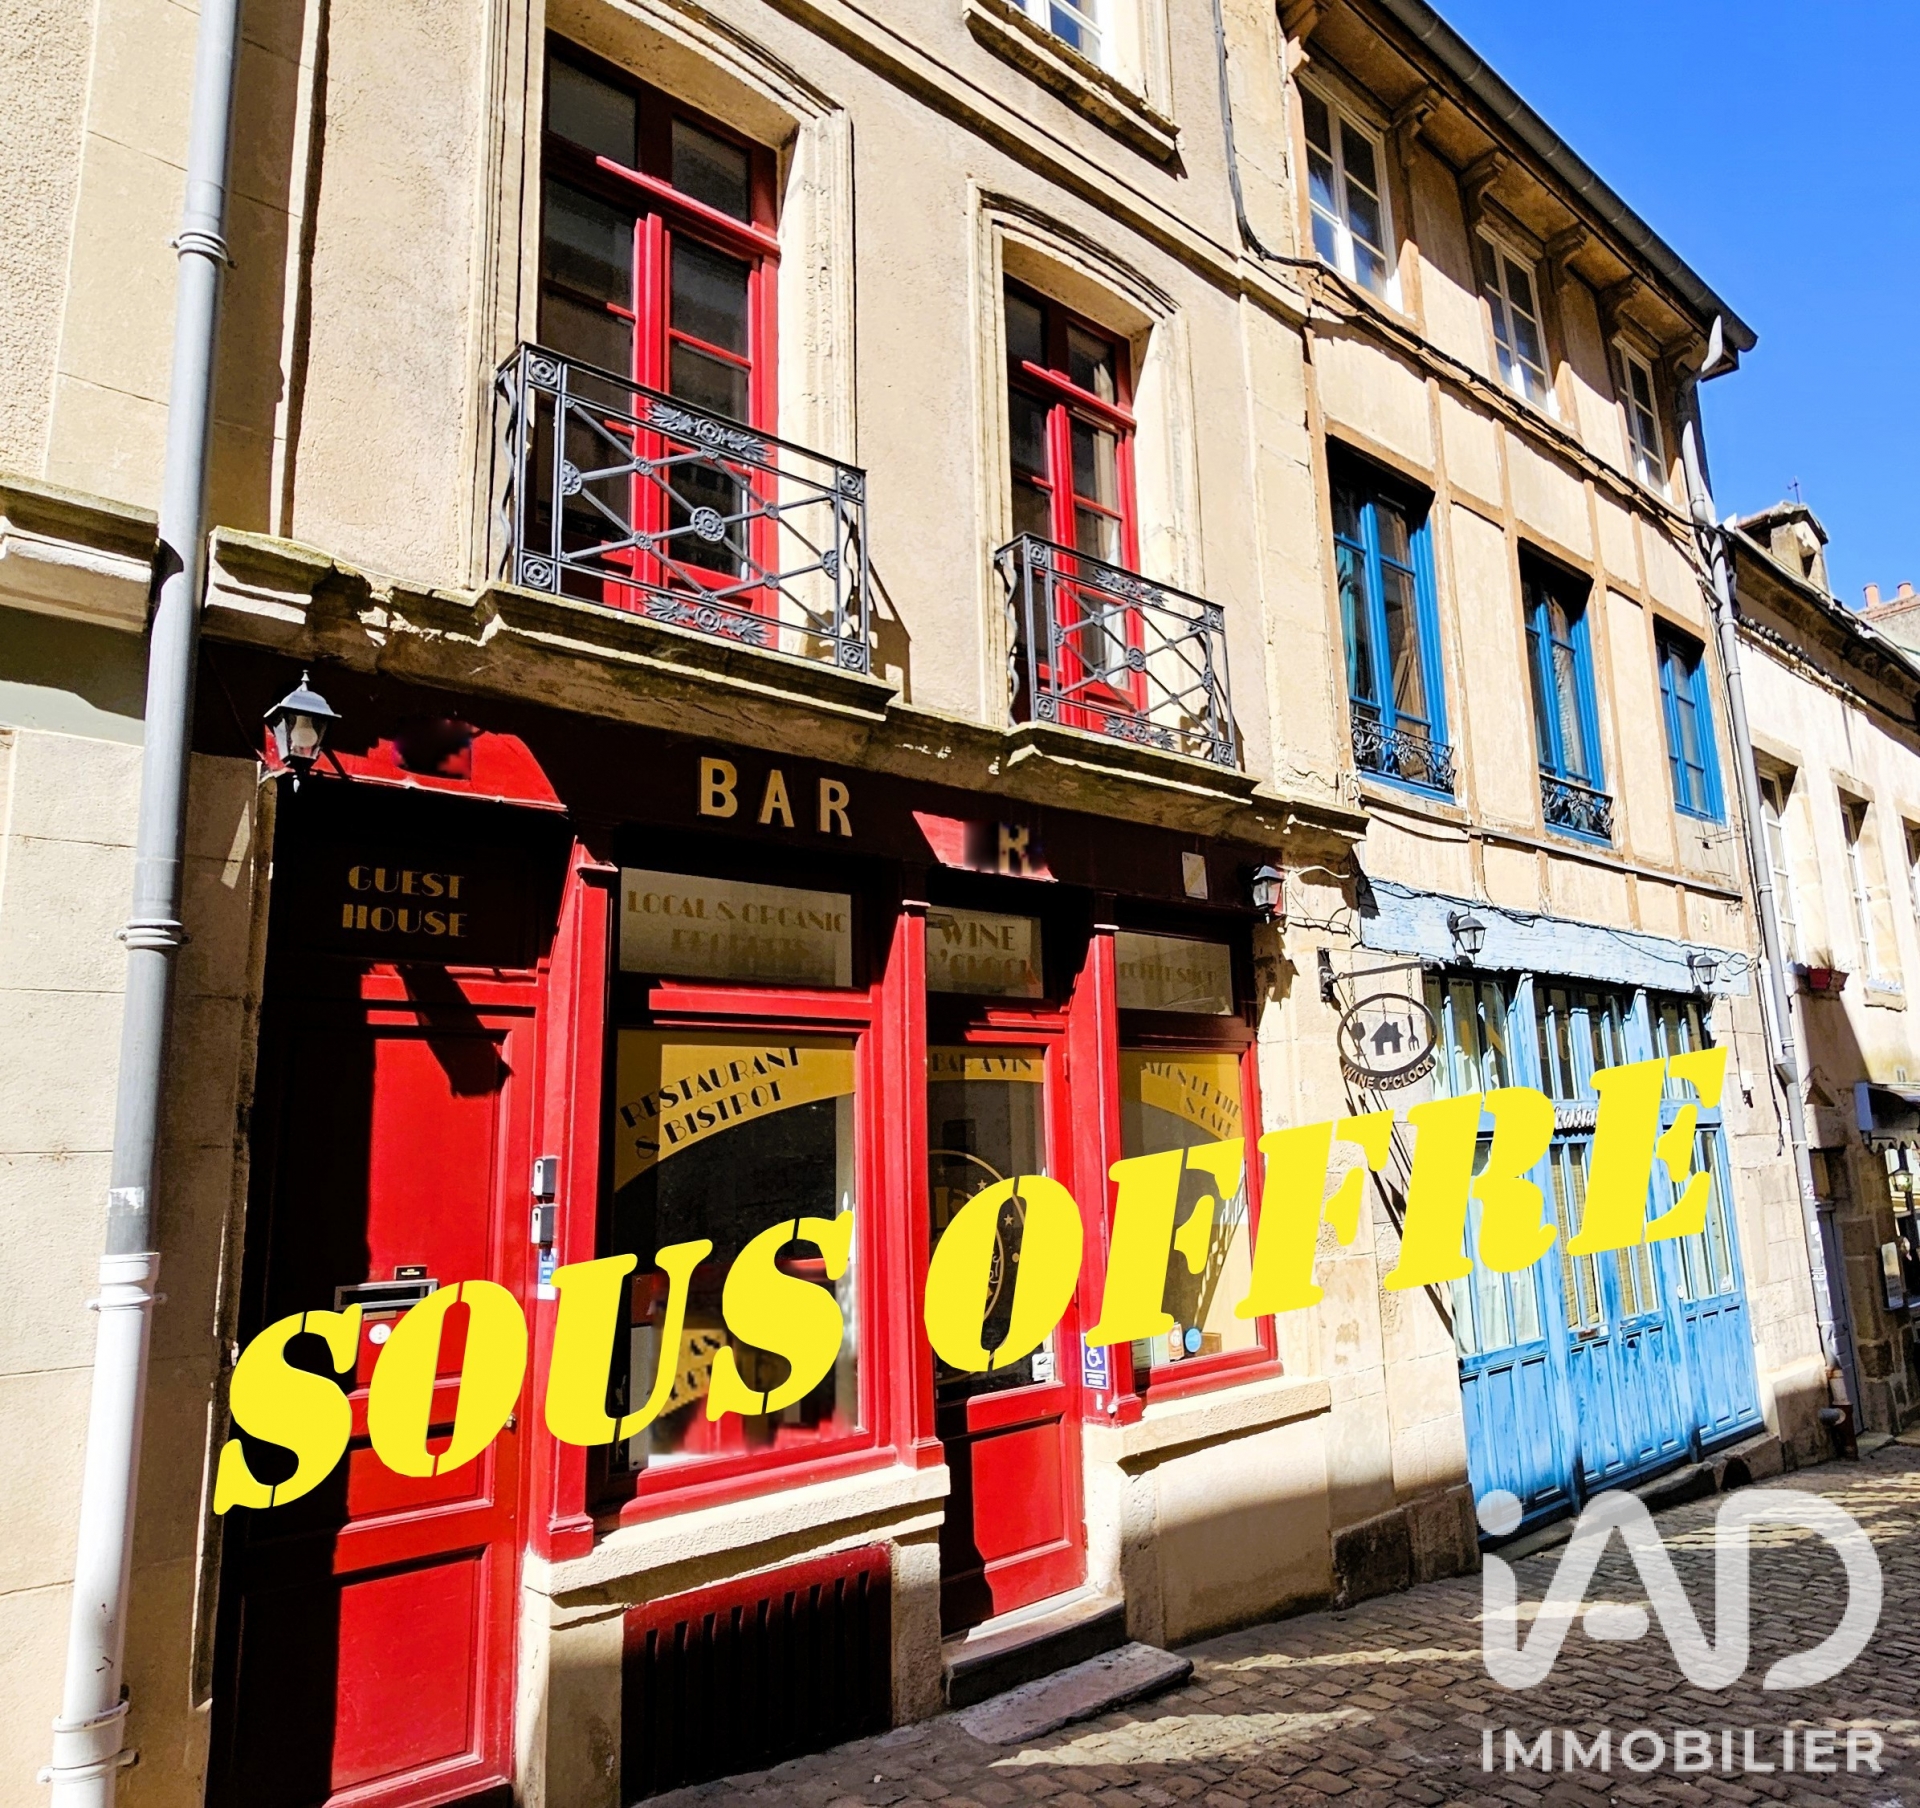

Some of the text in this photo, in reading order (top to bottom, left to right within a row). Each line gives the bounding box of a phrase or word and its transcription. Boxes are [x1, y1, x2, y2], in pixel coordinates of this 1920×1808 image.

[697, 756, 853, 838] BAR
[348, 865, 465, 899] GUEST
[342, 903, 468, 938] HOUSE
[627, 890, 711, 920] LOCAL
[741, 902, 848, 934] ORGANIC
[936, 918, 1016, 951] WINE
[620, 1046, 800, 1129] RESTAURANT
[1342, 1057, 1436, 1091] WINE O'CLOCK
[635, 1078, 783, 1160] & BISTROT
